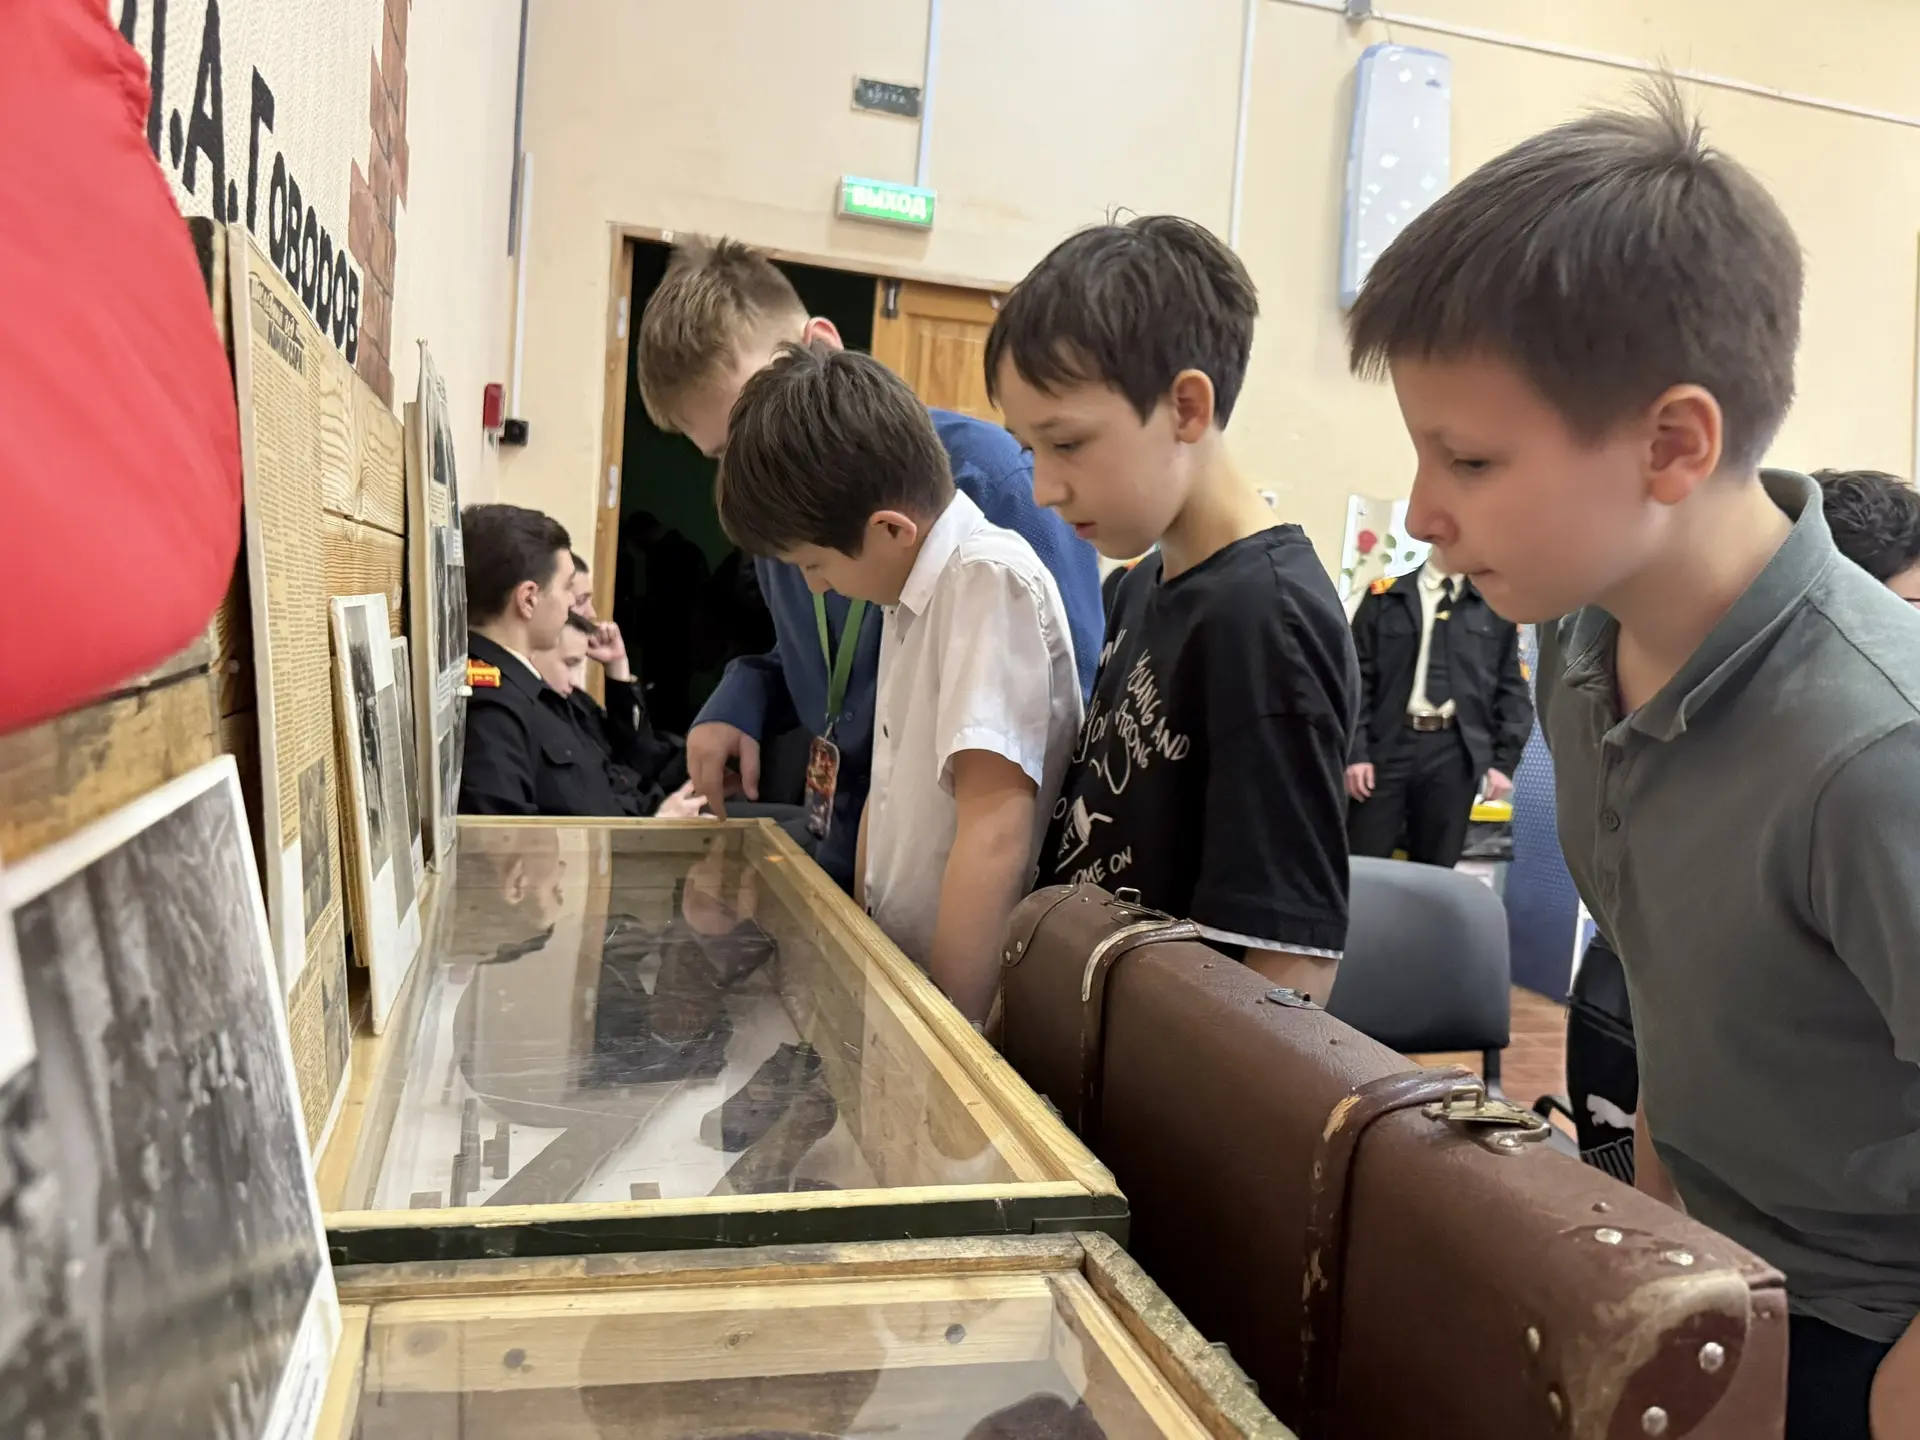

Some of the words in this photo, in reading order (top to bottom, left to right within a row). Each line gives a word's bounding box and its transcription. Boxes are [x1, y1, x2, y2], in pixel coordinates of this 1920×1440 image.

[852, 186, 927, 220] ВЫХОД
[1150, 716, 1190, 761] AND
[1110, 845, 1133, 874] ON
